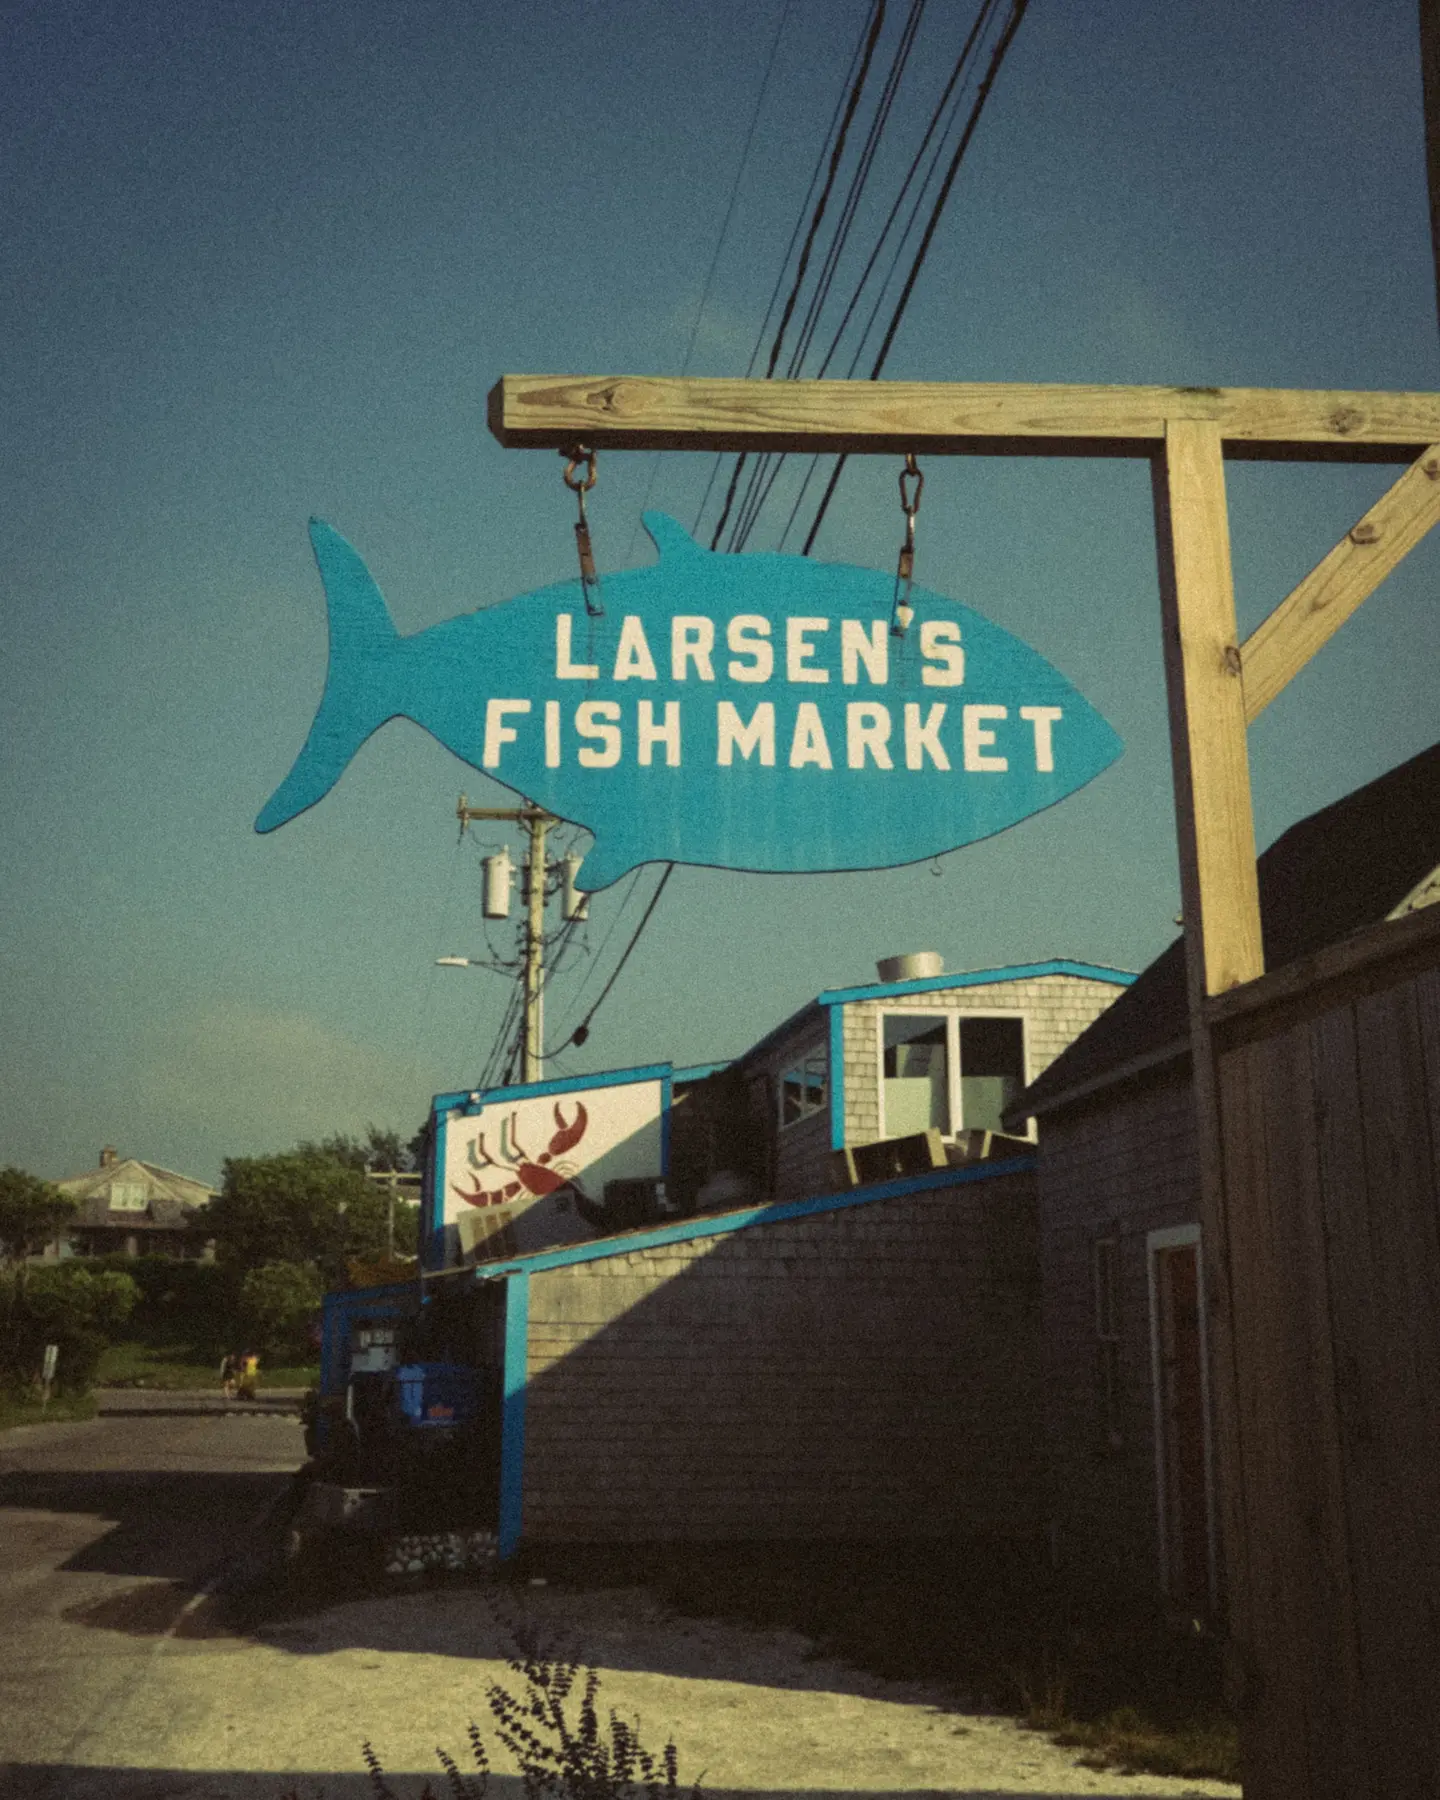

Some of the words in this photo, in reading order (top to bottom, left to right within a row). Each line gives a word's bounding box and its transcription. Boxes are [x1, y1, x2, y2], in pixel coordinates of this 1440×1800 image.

[555, 605, 965, 687] LARSEN'S
[482, 698, 681, 769] FISH
[716, 701, 1063, 773] MARKET
